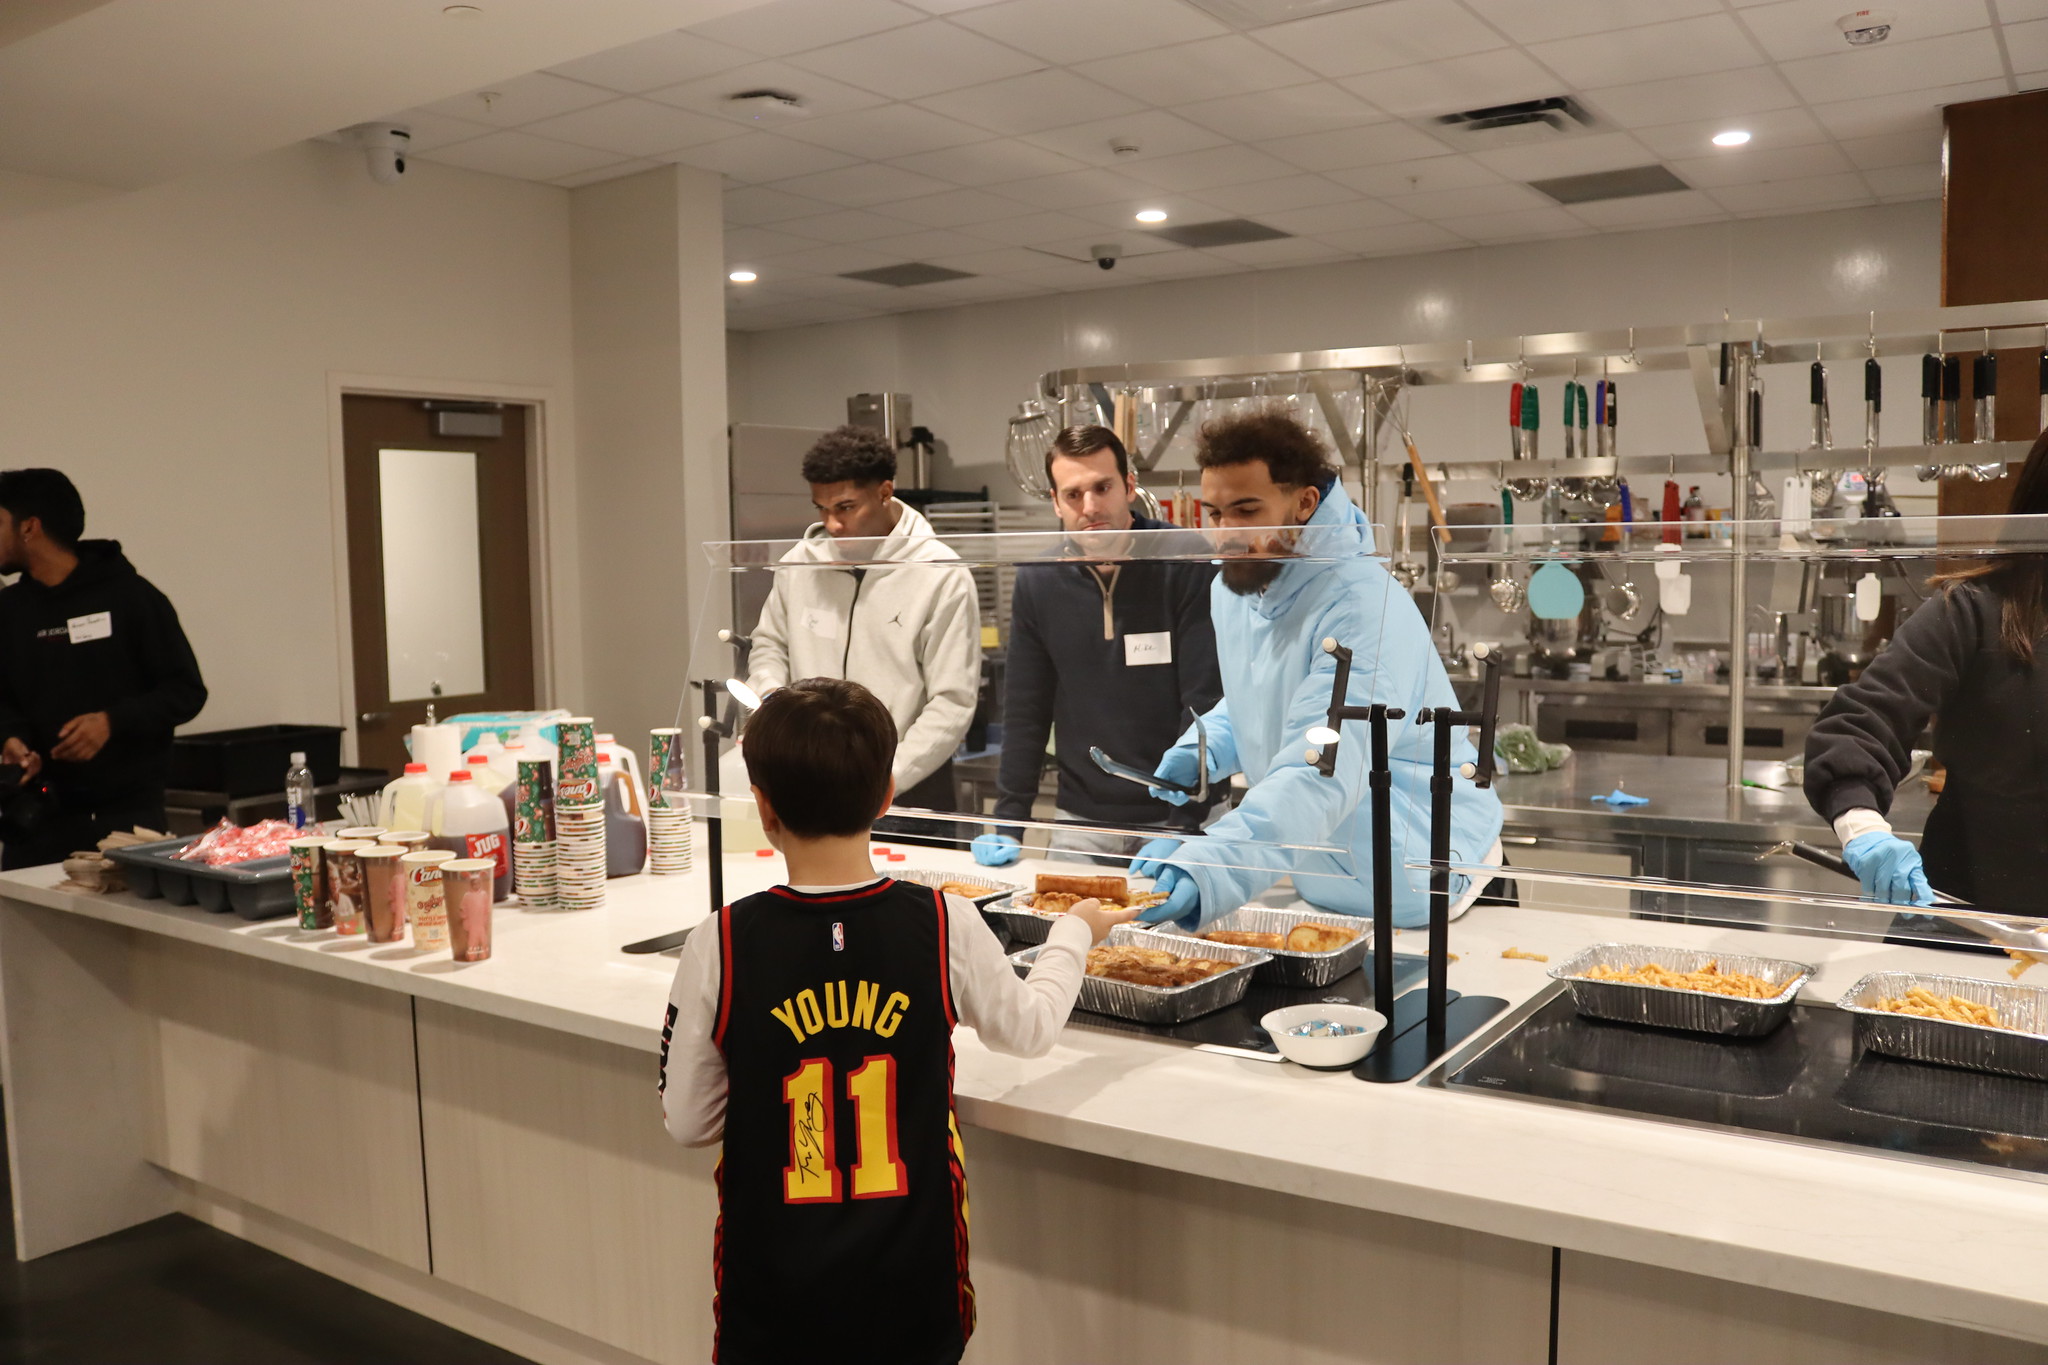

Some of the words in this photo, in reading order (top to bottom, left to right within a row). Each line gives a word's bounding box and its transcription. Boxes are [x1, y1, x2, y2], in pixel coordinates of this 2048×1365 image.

[473, 834, 501, 857] JUG
[771, 980, 911, 1044] YOUNG
[783, 1054, 909, 1204] 11
